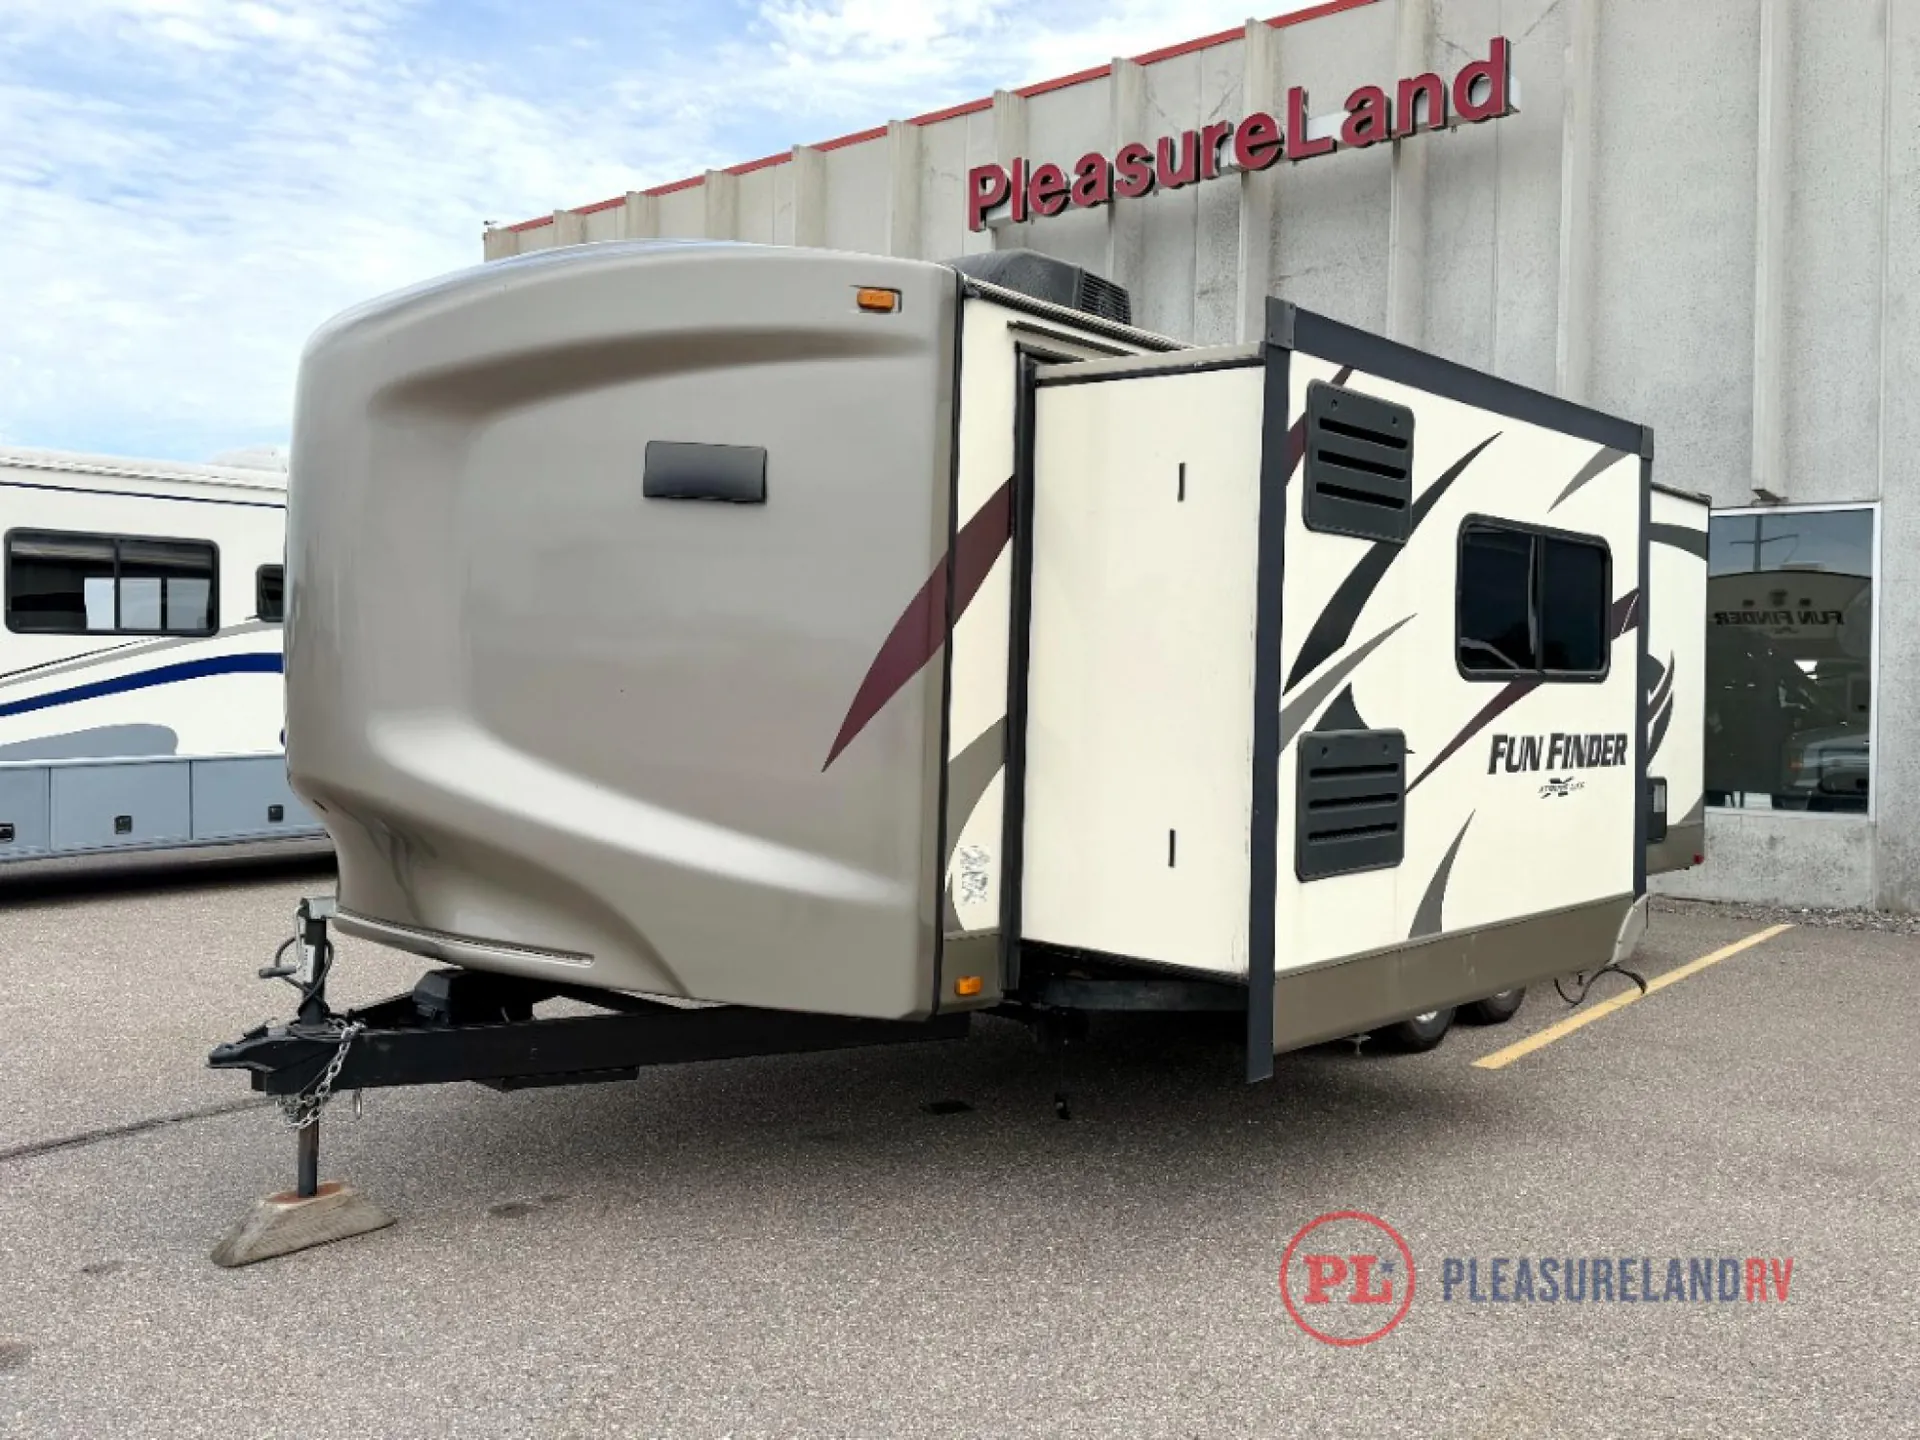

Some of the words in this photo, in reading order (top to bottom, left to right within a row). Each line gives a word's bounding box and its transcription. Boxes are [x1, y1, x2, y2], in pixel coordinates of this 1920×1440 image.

[968, 35, 1515, 232] PleasureLand
[1487, 733, 1544, 775] FUN
[1545, 732, 1628, 770] FINDER
